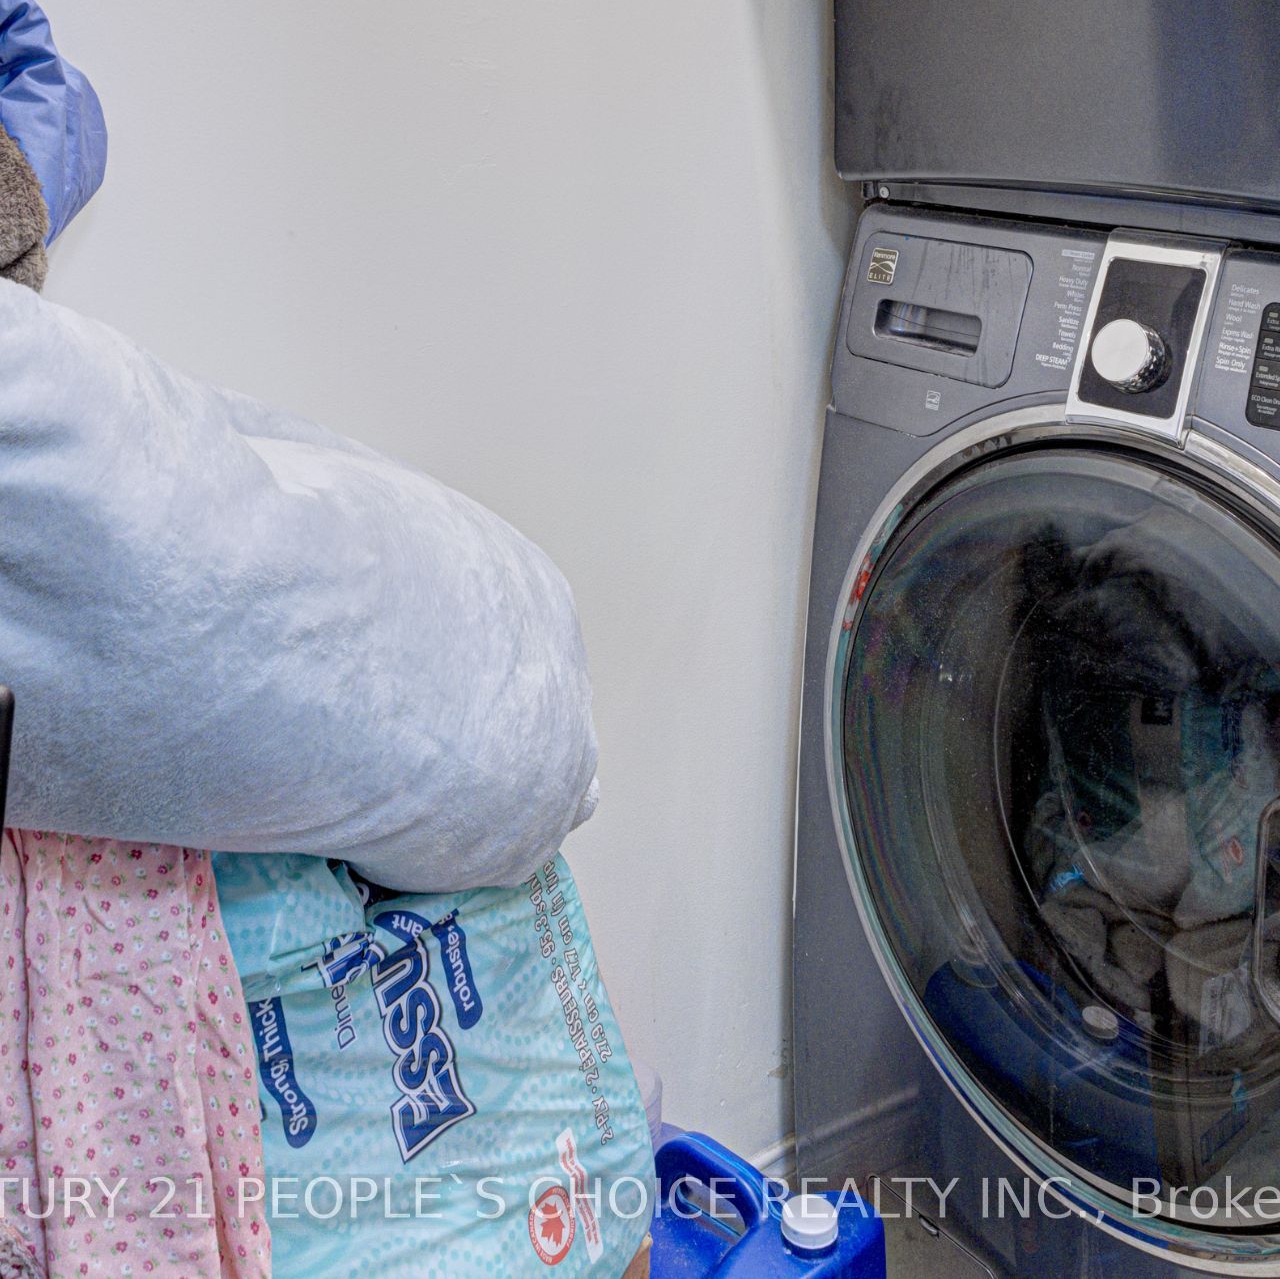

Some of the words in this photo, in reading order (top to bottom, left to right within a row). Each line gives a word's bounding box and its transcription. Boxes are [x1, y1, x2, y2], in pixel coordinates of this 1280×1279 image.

[869, 272, 891, 282] ELITE
[1035, 353, 1049, 362] DEEP
[1049, 356, 1068, 366] STEAM
[534, 920, 555, 959] 95.3
[558, 915, 574, 945] cm
[331, 984, 357, 1051] Dime
[551, 966, 597, 1072] ÉPAISSEURS
[583, 992, 600, 1023] cm
[256, 997, 281, 1063] Thick
[590, 1022, 612, 1064] 27.9
[586, 1067, 600, 1086] 2
[592, 1096, 614, 1145] 2-PLY
